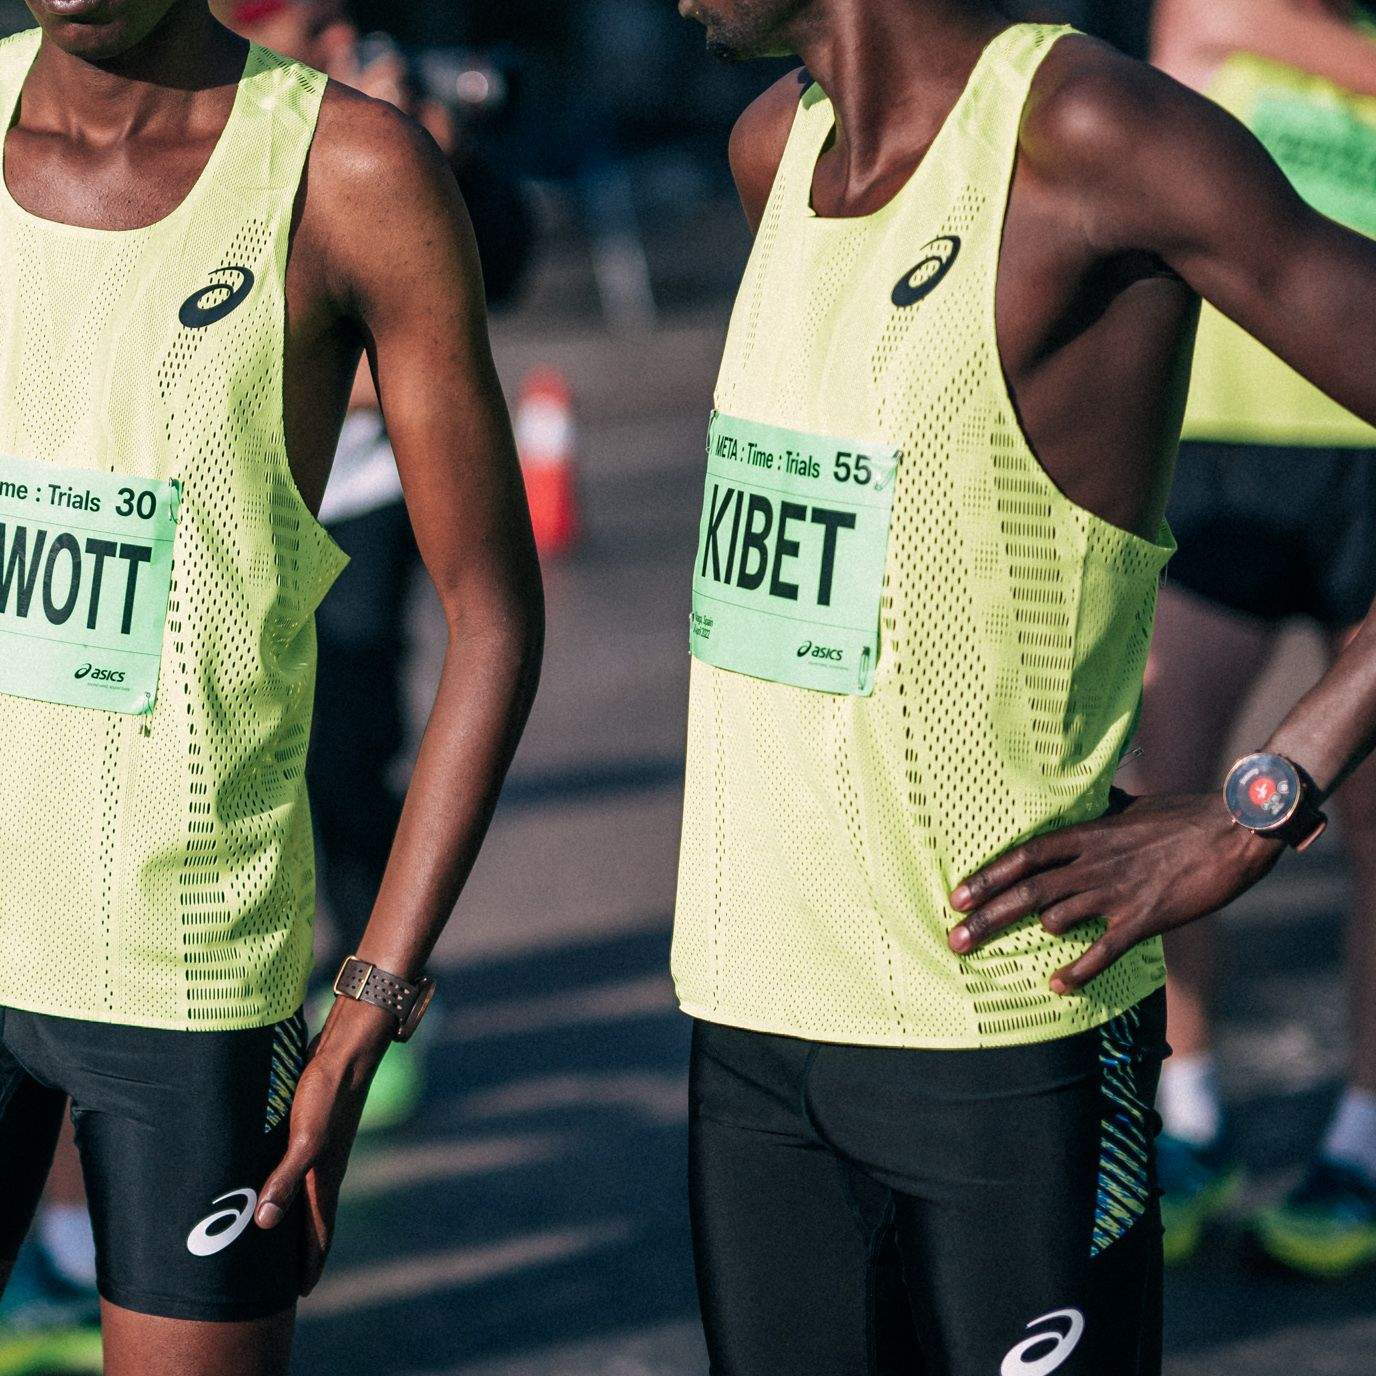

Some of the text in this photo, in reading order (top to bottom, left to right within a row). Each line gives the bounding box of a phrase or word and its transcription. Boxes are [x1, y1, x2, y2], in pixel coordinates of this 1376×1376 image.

[715, 435, 738, 461] META
[747, 442, 774, 469] Time
[786, 450, 821, 479] Trials
[833, 451, 872, 486] 55
[48, 483, 101, 512] Trials
[115, 487, 157, 520] 30
[701, 484, 857, 607] KIBET
